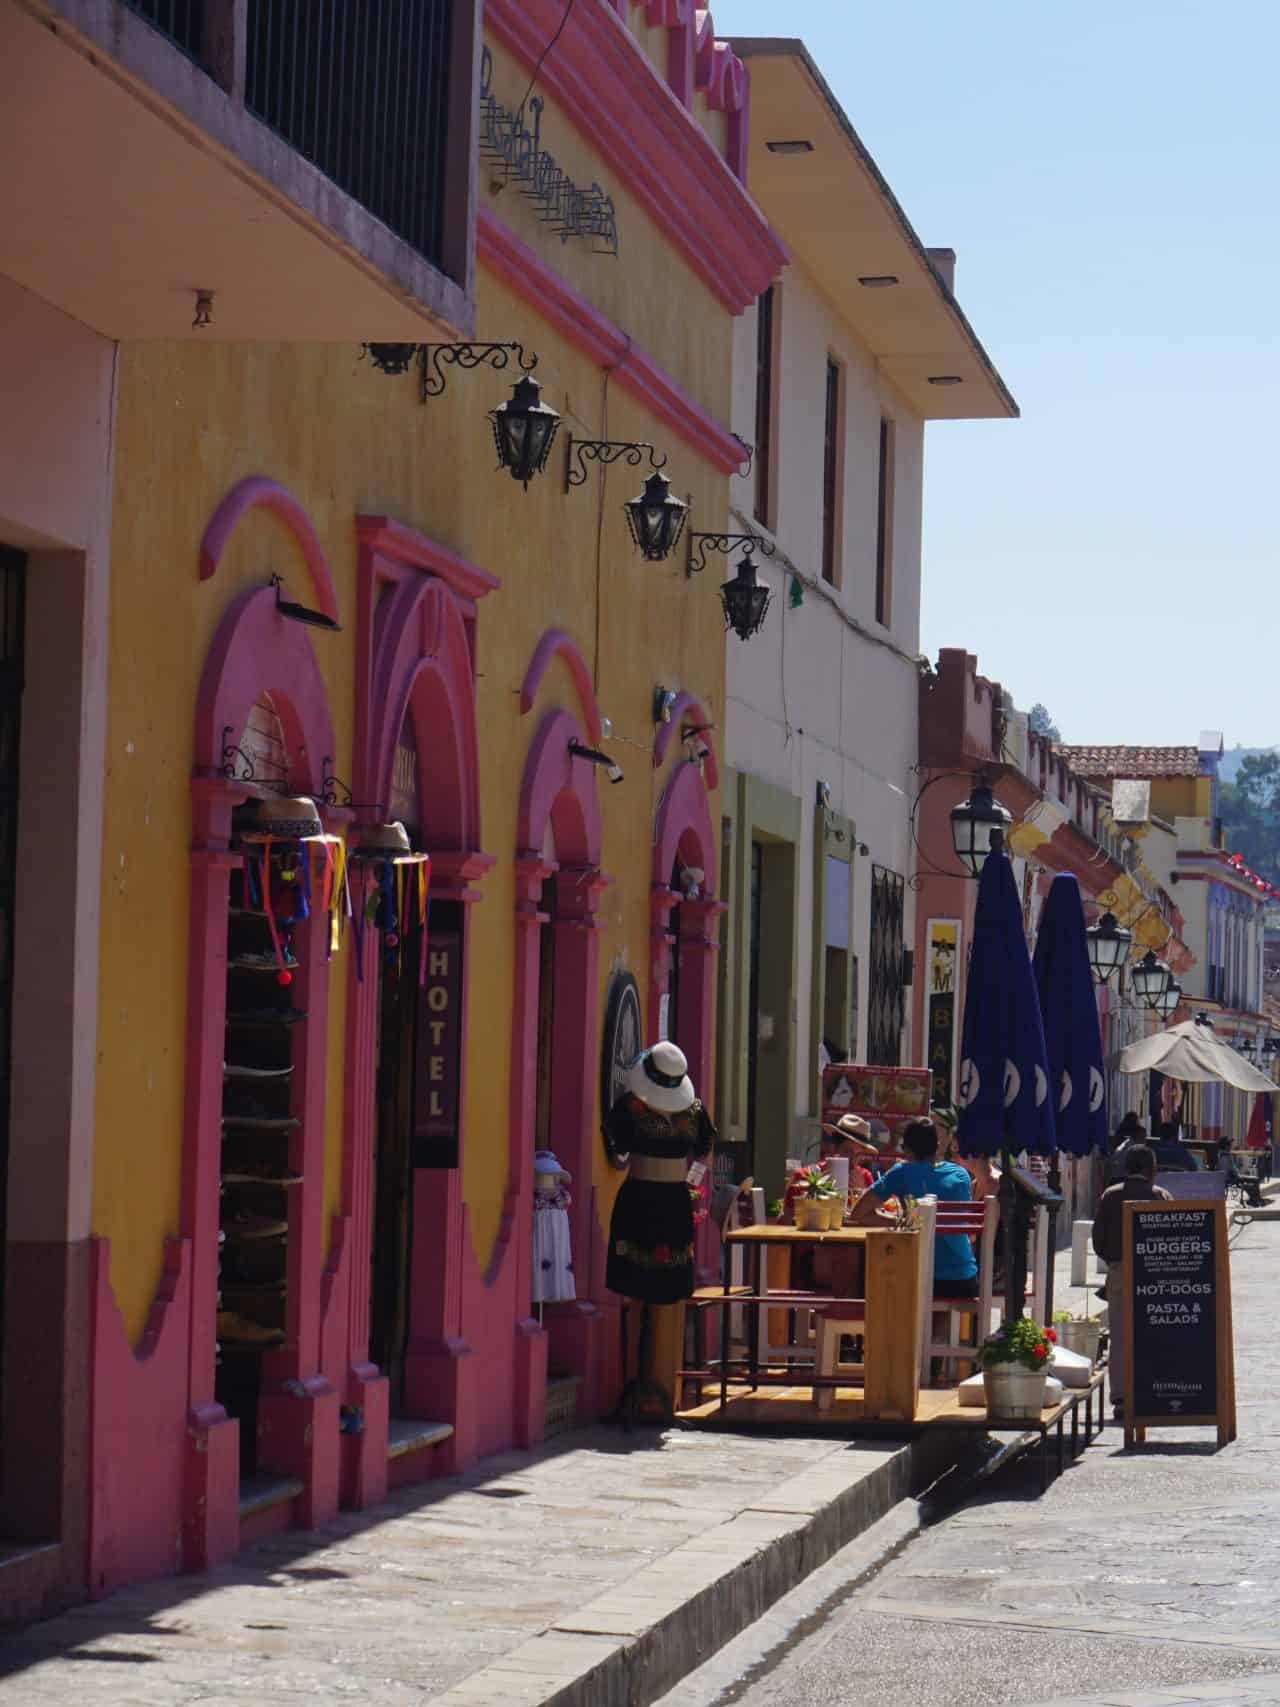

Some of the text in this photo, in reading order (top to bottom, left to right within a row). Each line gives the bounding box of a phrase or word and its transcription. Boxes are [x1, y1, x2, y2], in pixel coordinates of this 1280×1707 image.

[428, 951, 449, 1115] HOTEL
[934, 1008, 950, 1097] BAR
[1139, 1212, 1207, 1223] BREAKFAST
[1136, 1241, 1212, 1254] BURGERS
[1136, 1284, 1212, 1296] HOT-DOGS
[1147, 1303, 1189, 1313] PASTA
[1149, 1315, 1200, 1325] SALADS
